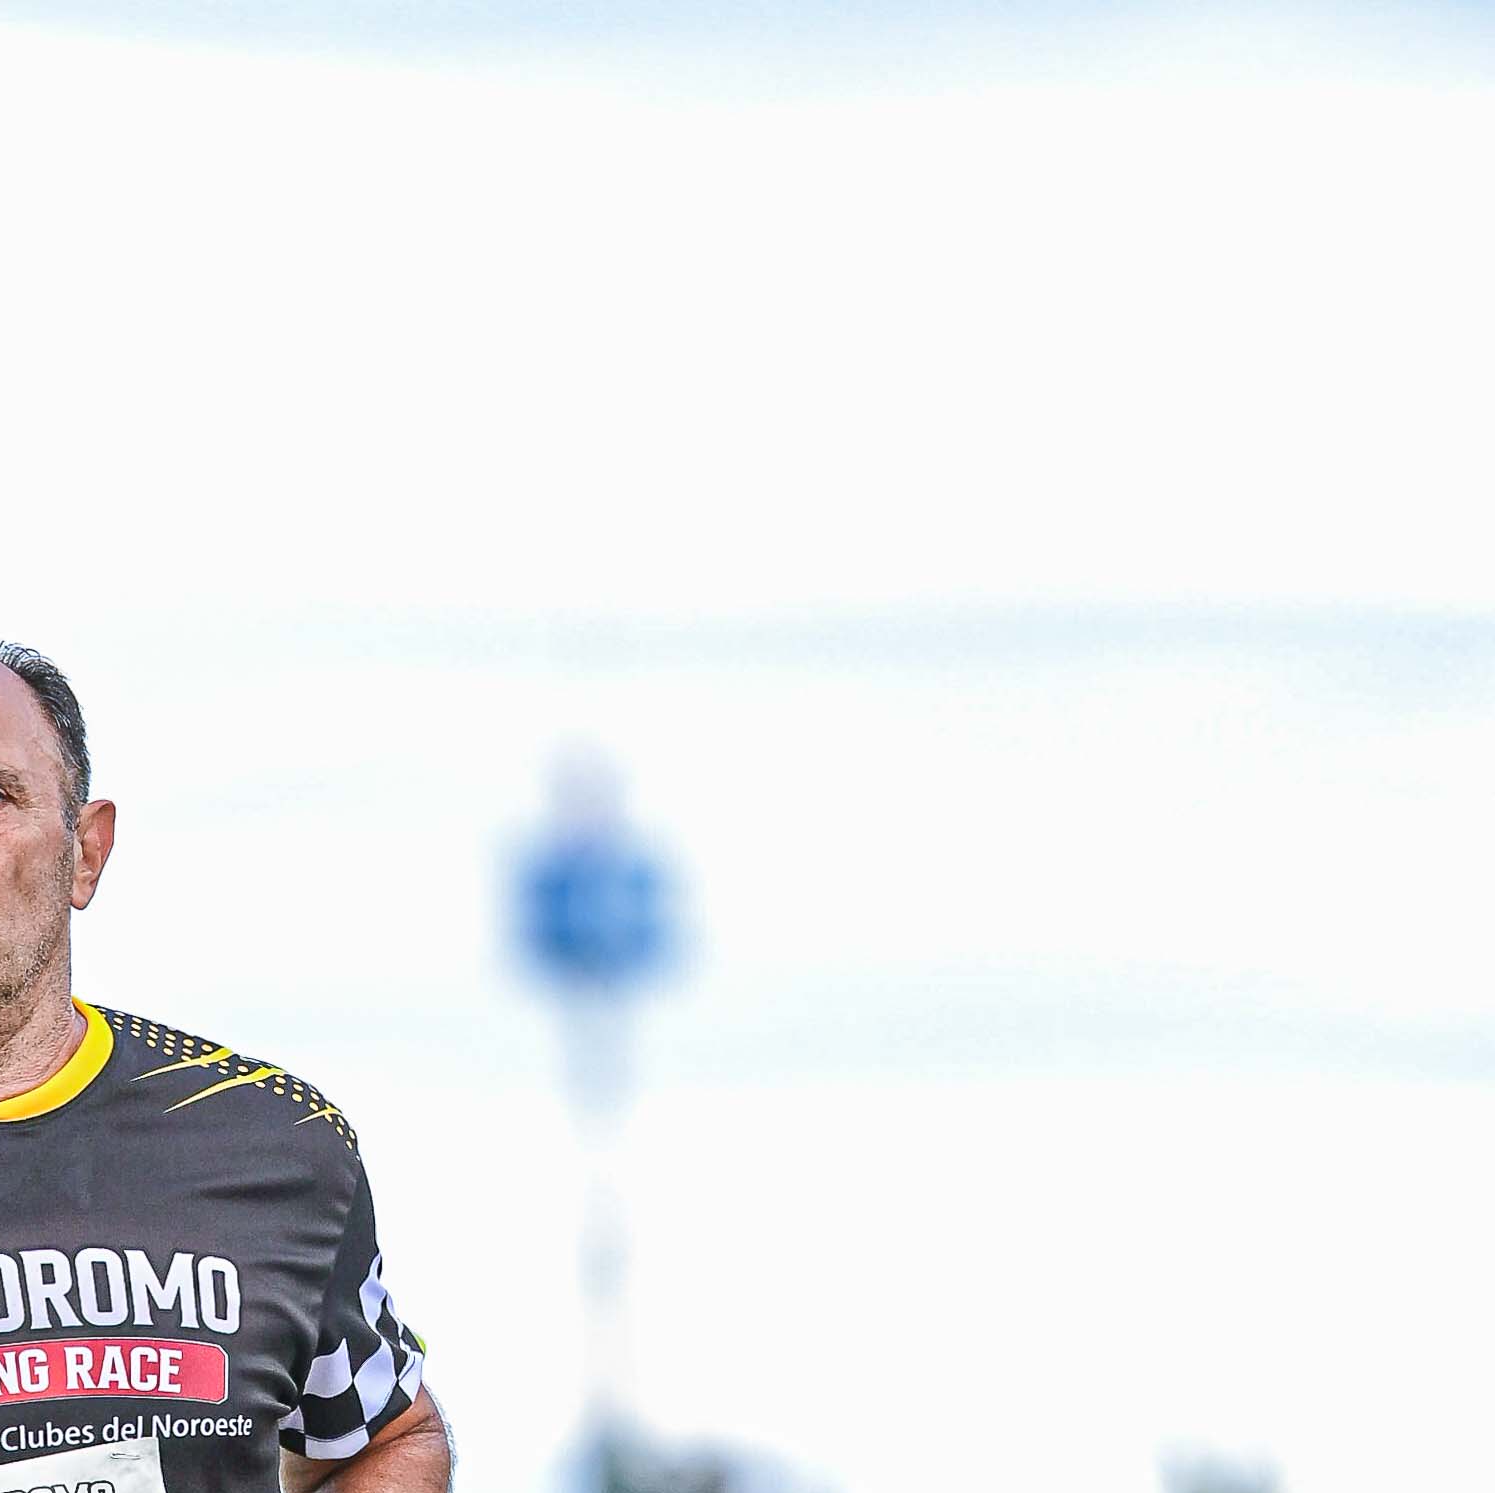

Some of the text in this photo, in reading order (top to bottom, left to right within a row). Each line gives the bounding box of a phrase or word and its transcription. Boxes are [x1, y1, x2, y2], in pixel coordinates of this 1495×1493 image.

[64, 1344, 183, 1394] RACE
[0, 1421, 94, 1452] Clubes
[102, 1416, 143, 1442] del
[152, 1413, 253, 1438] Noroeste
